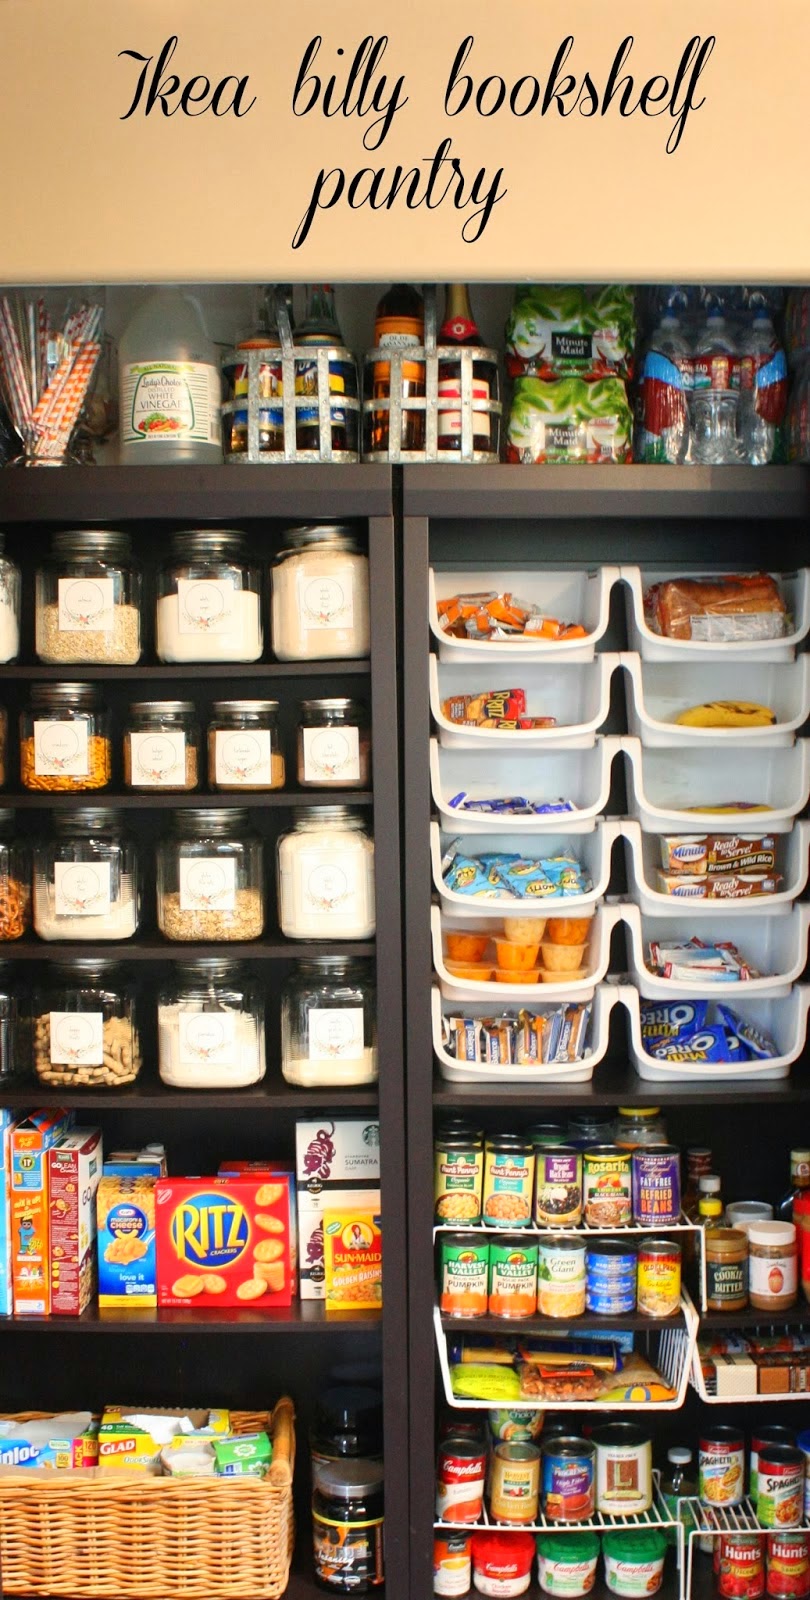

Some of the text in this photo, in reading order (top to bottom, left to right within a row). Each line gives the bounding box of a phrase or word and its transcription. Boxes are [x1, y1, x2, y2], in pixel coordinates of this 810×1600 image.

[556, 336, 589, 347] Minute
[560, 345, 584, 355] Maid
[148, 392, 174, 400] WHITE
[549, 427, 581, 438] Minute
[553, 436, 578, 446] Maid
[713, 837, 740, 851] Ready
[673, 846, 706, 858] Minute
[726, 843, 753, 858] Serve!
[708, 862, 732, 872] Brown
[740, 855, 756, 867] Wild
[757, 854, 773, 863] Rice
[712, 878, 740, 893] Ready
[345, 1158, 378, 1166] SUMATRA
[640, 1176, 672, 1187] FAT FREE
[640, 1189, 673, 1200] REFRIED
[641, 1199, 673, 1213] BEANS
[175, 1204, 245, 1259] RITZ
[210, 1248, 237, 1256] CRACKERS
[448, 1260, 486, 1269] HARVEST
[497, 1262, 535, 1271] HARVEST
[550, 1257, 576, 1266] Green
[451, 1267, 483, 1275] VALLEY
[501, 1268, 532, 1276] VALLEY
[550, 1264, 575, 1273] Giant
[119, 1273, 145, 1281] love it
[332, 1274, 358, 1287] GOLDEN
[714, 1270, 744, 1282] COOKIE
[447, 1280, 484, 1288] PUMPKIN
[497, 1281, 533, 1289] PUMPKIN
[714, 1282, 744, 1293] BUTTER
[100, 1439, 135, 1455] GLAD
